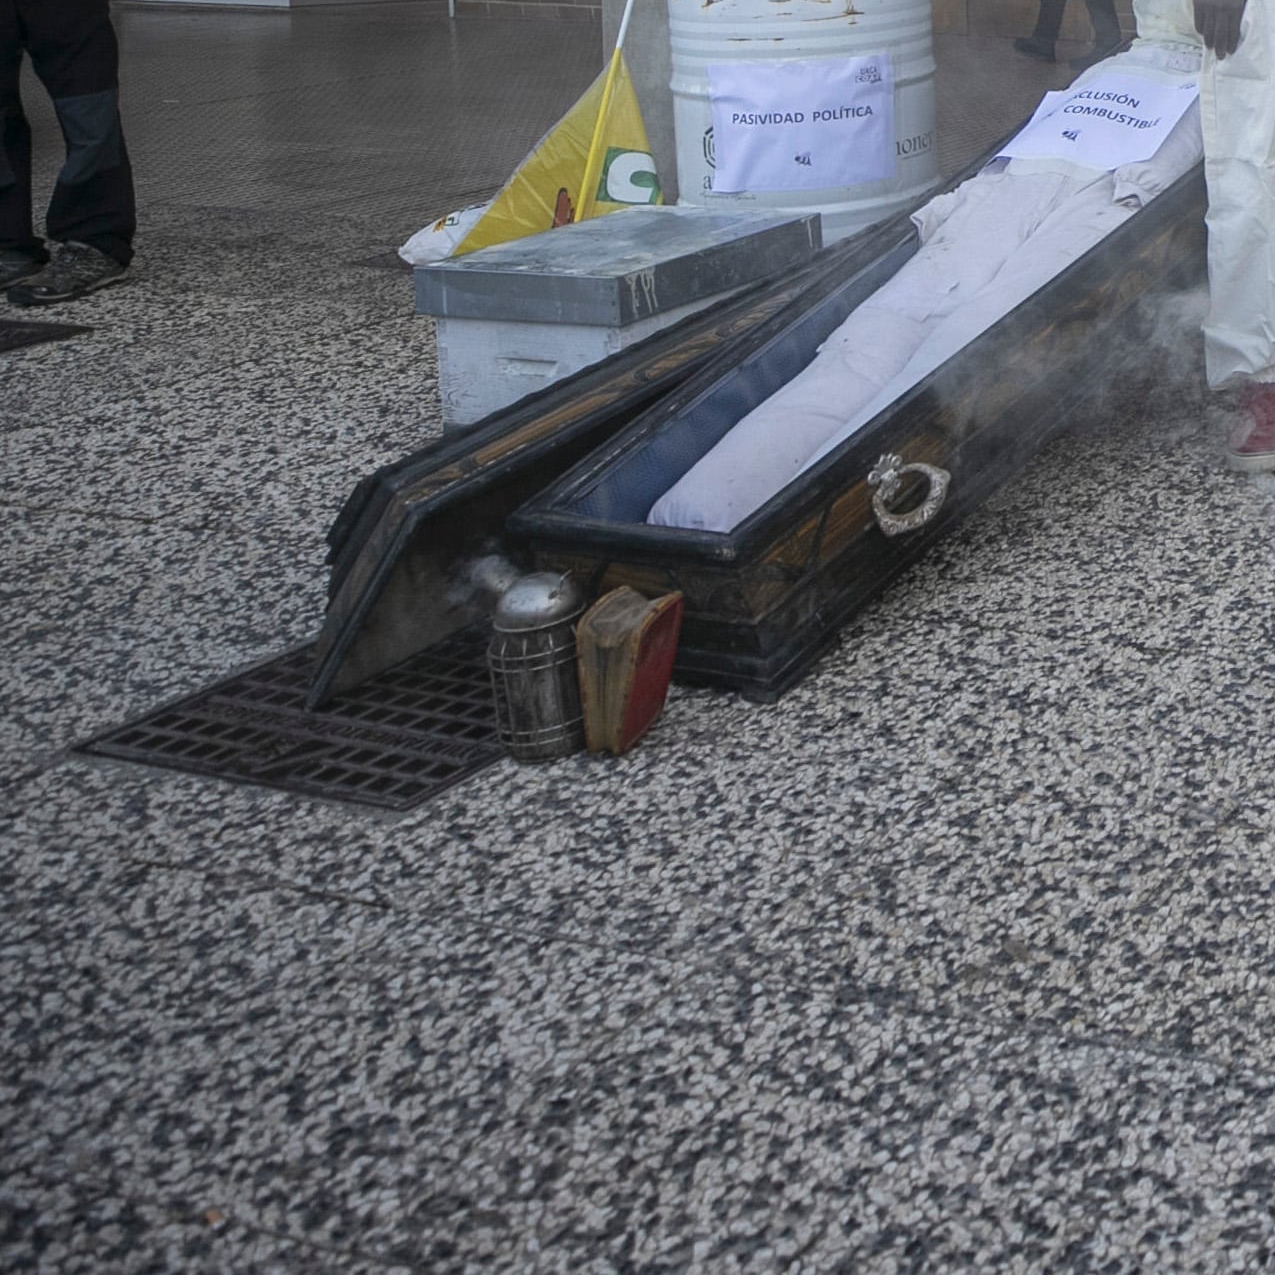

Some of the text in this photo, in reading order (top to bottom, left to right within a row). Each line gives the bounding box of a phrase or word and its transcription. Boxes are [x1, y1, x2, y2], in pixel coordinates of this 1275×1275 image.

[1074, 90, 1141, 109] CLUSIÓN
[732, 105, 874, 126] PASIVIDAD POLÍTICA
